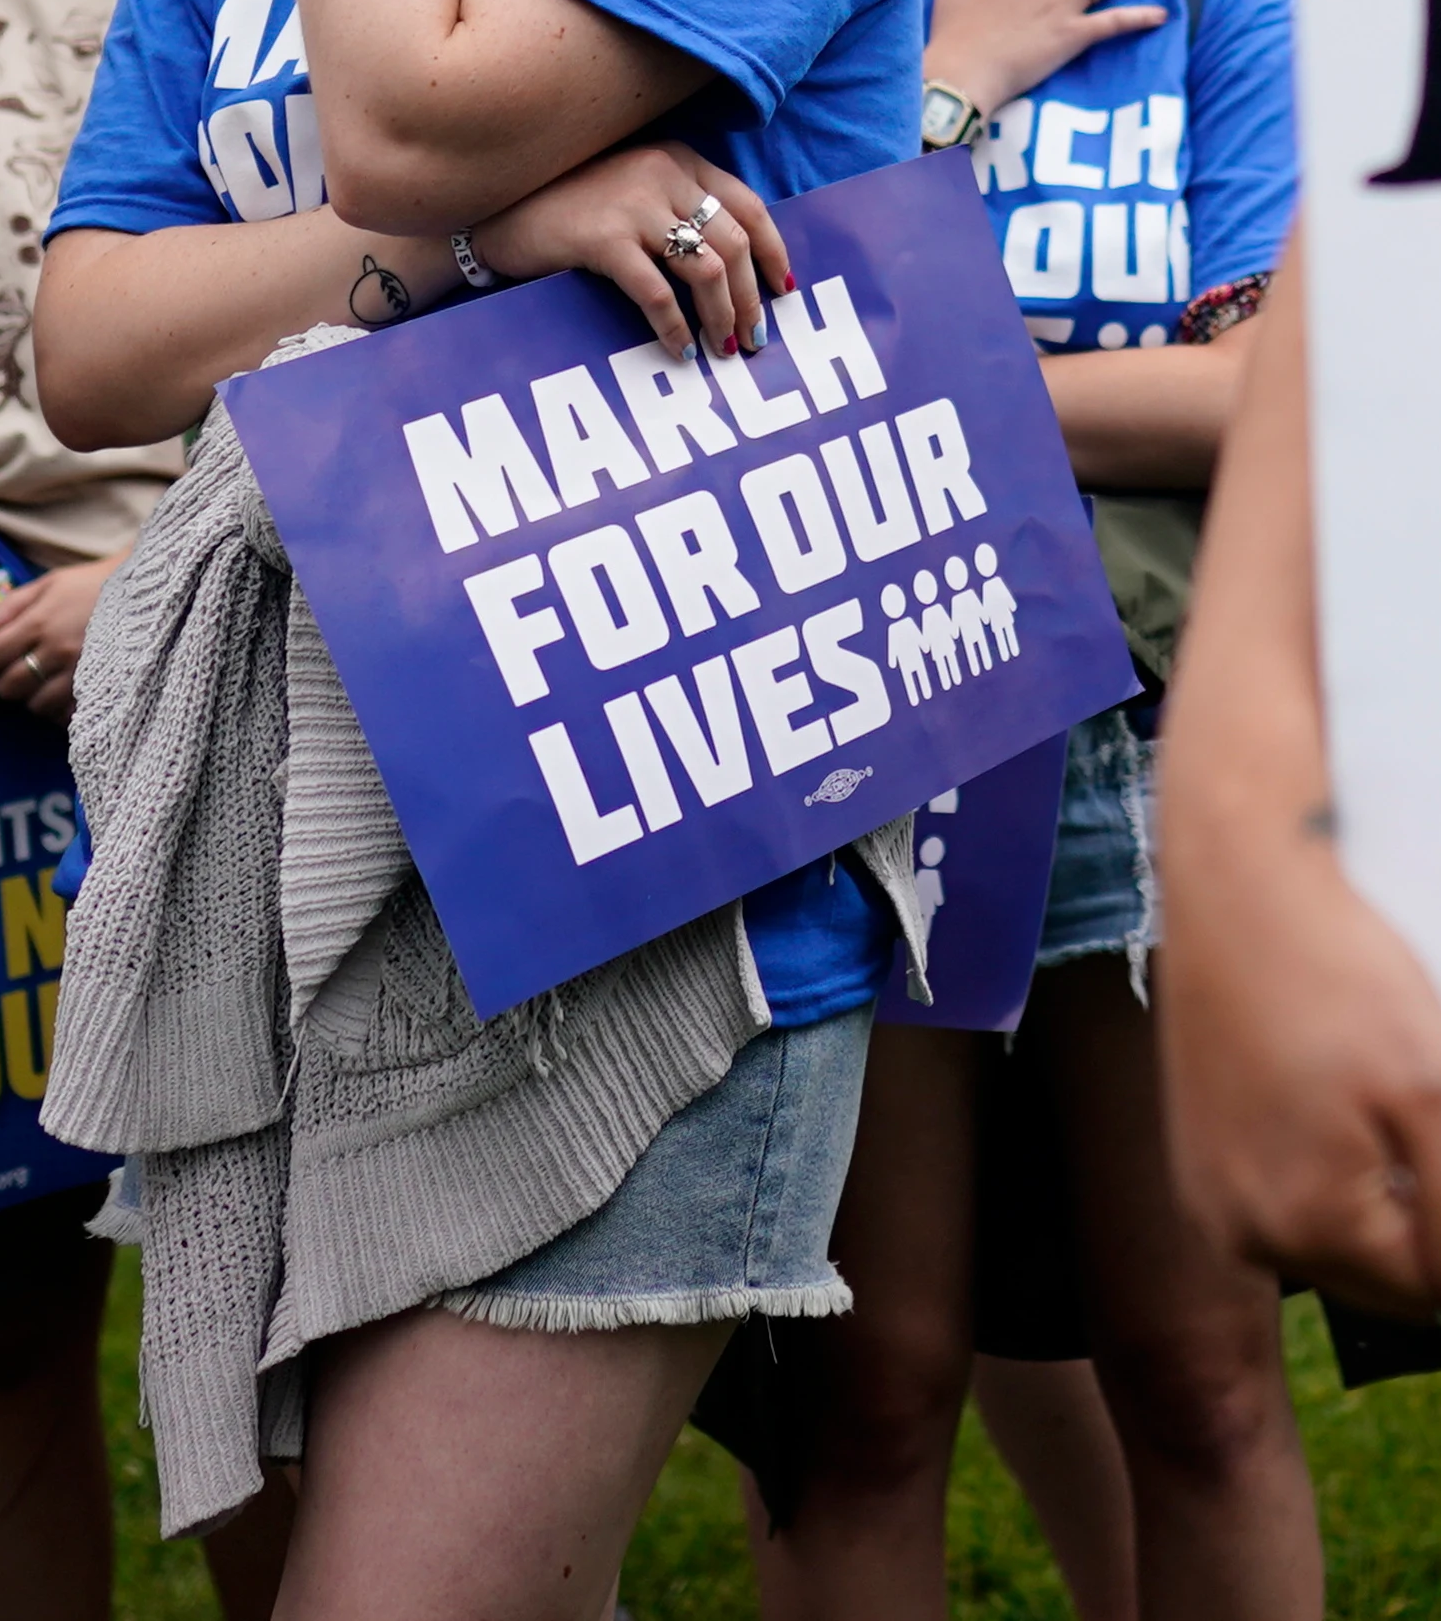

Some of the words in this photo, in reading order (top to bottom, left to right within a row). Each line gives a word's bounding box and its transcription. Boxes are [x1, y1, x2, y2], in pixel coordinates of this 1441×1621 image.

[970, 93, 1185, 196] RCH
[402, 275, 888, 554] MARCH
[463, 489, 761, 708] FOR
[739, 397, 987, 596] OUR
[528, 598, 891, 866] LIVES
